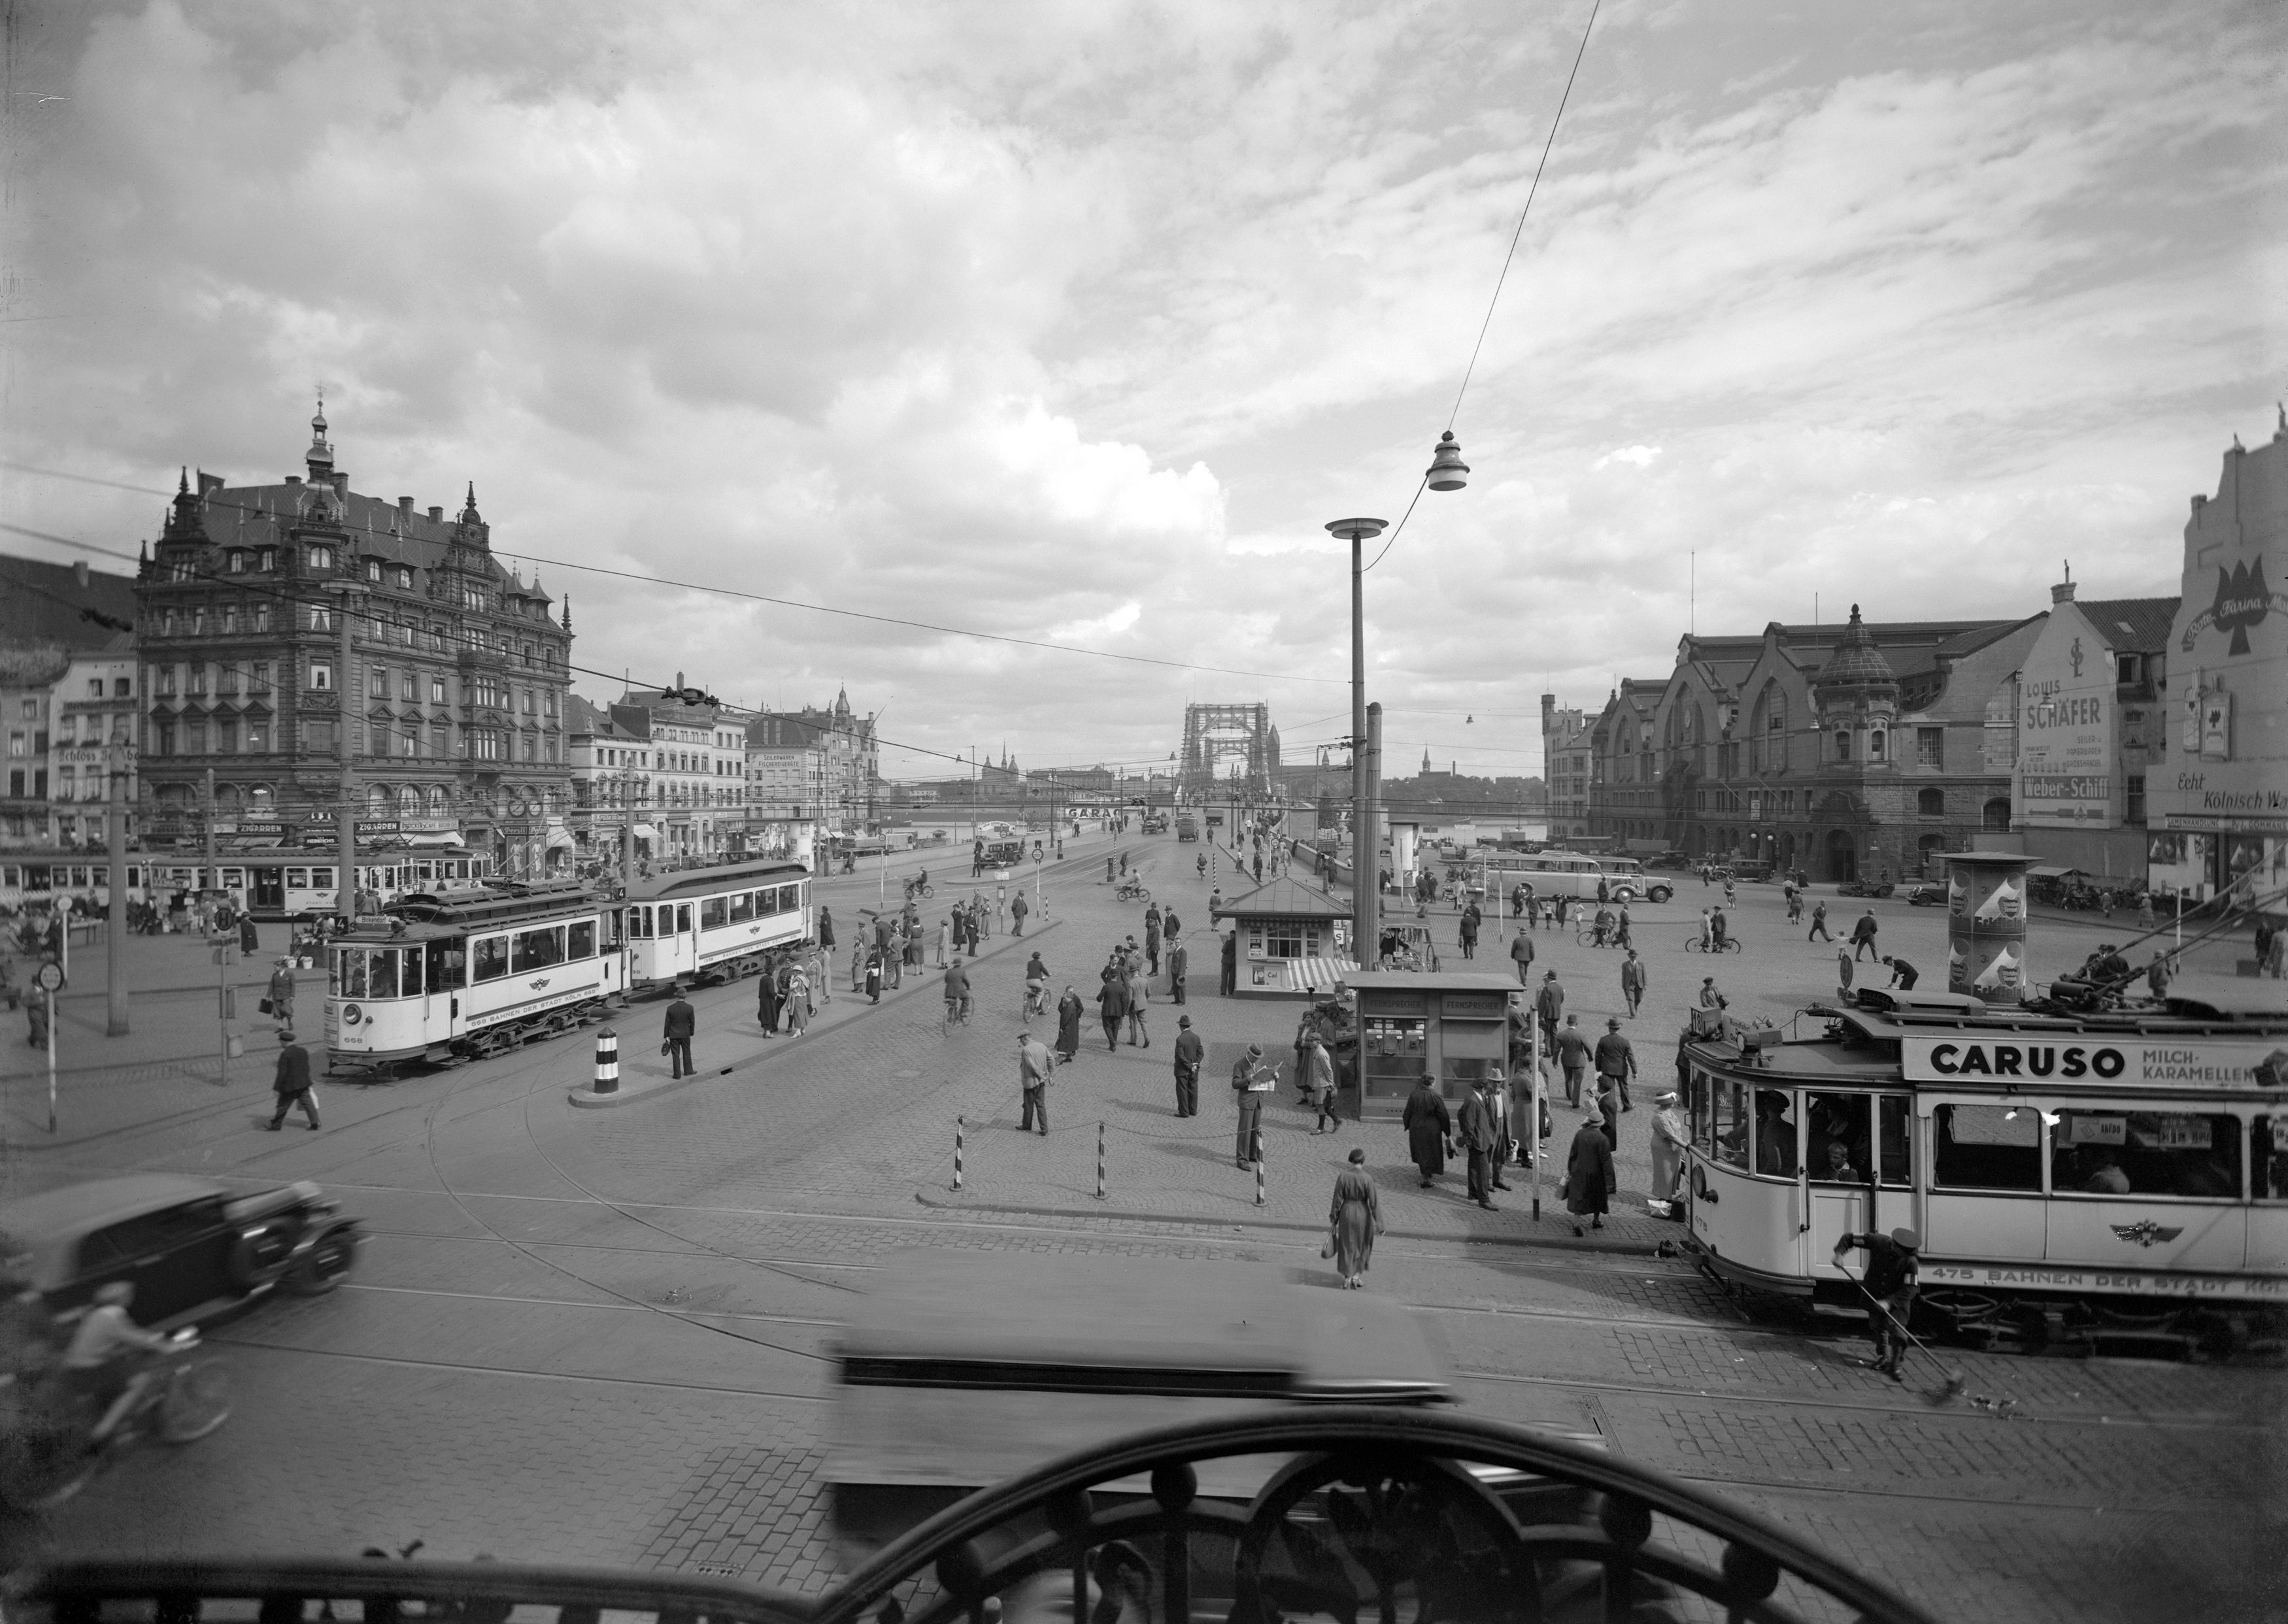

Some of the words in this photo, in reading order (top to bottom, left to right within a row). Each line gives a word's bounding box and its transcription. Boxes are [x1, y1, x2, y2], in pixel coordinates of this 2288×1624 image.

[2220, 597, 2261, 619] Farina
[2027, 679, 2060, 698] LOUIS
[2027, 697, 2100, 729] SCHÄFER
[2066, 759, 2101, 767] GROSSHANDEL
[2025, 777, 2108, 798] Weber-Schiff
[2178, 772, 2205, 790] Echt
[2204, 789, 2263, 809] Kölnisch
[619, 889, 624, 897] 4
[219, 912, 229, 927] H
[337, 919, 345, 929] 4
[490, 1009, 520, 1021] BAHNEN
[523, 1004, 537, 1013] DER
[541, 998, 562, 1008] STADT
[565, 993, 581, 1001] KÖLN
[1370, 999, 1422, 1008] FERNSPRECHER
[1447, 1001, 1498, 1010] FERNSPRECHER
[1692, 1011, 1702, 1032] 18
[1730, 1018, 1750, 1033] Rundfahrt
[1930, 1044, 2126, 1078] CARUSO
[2143, 1049, 2200, 1065] MILCH-
[2143, 1065, 2253, 1082] KARAMELLEN
[1932, 1267, 1974, 1280] 475
[1988, 1270, 2082, 1286] BAHNEN
[2095, 1276, 2142, 1289] DER
[2154, 1276, 2229, 1293] STADT
